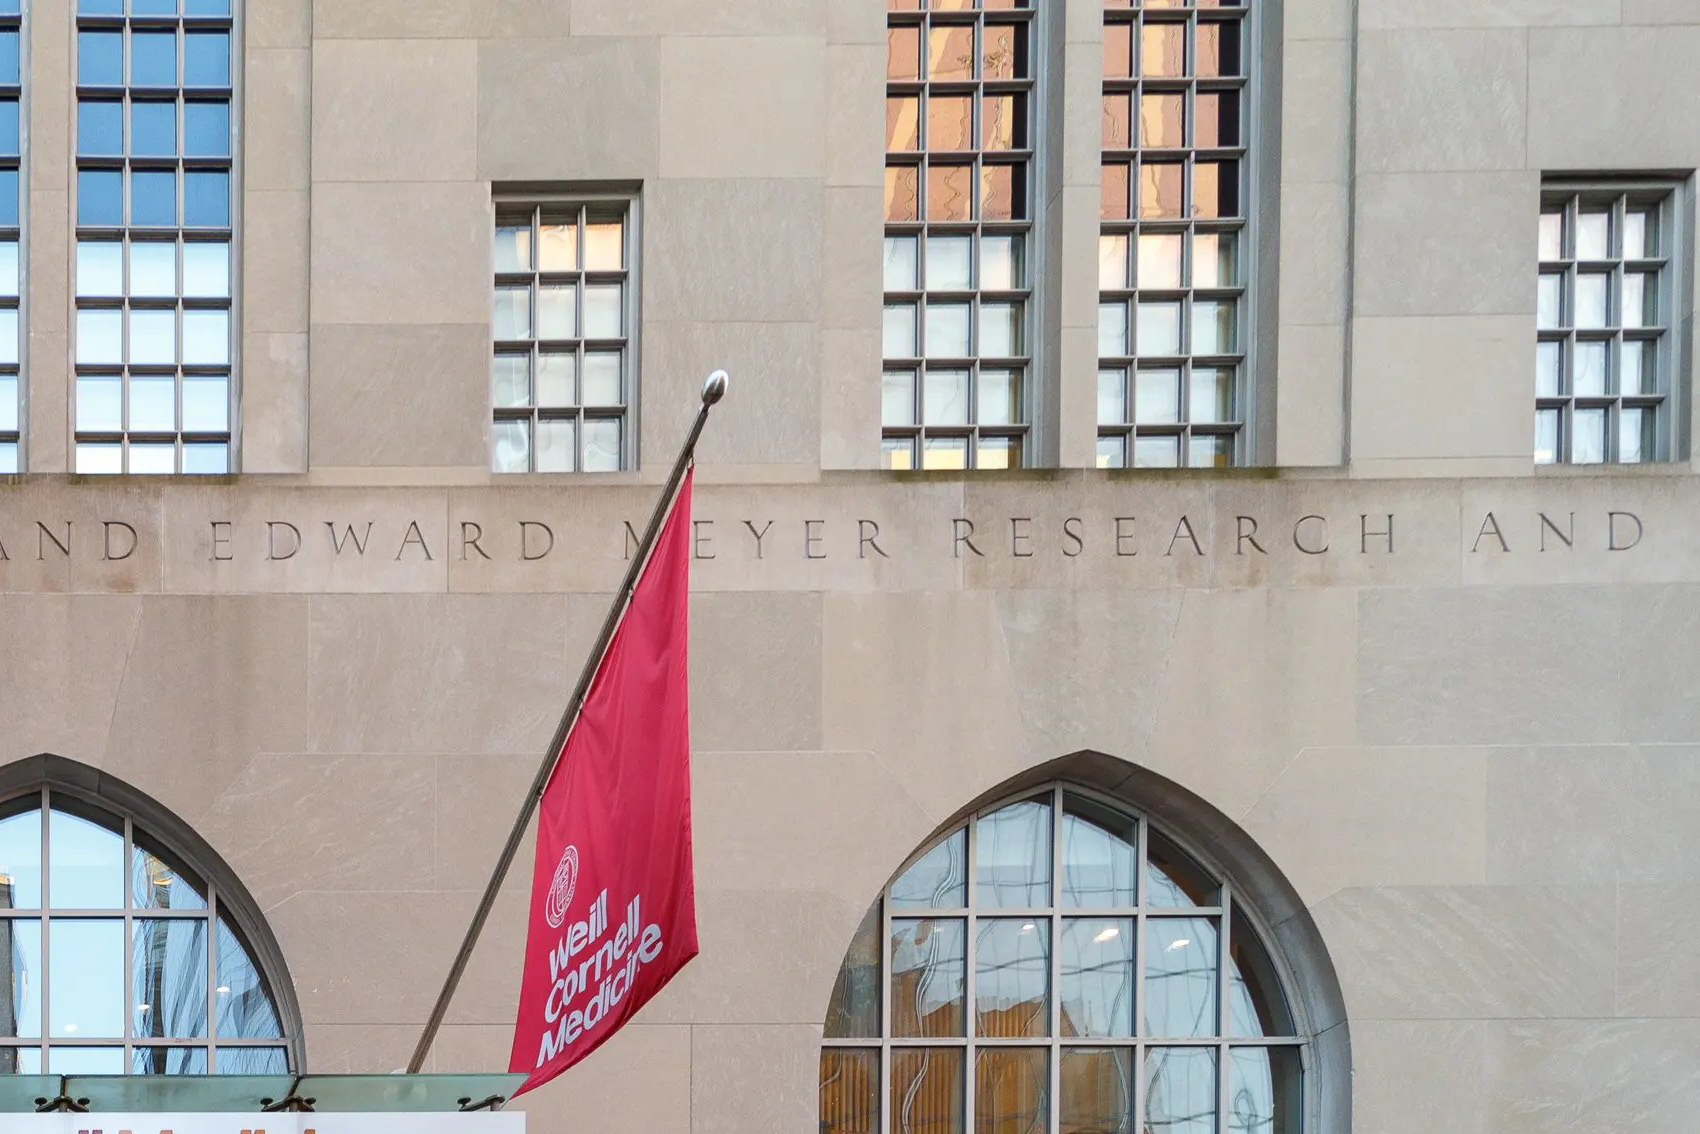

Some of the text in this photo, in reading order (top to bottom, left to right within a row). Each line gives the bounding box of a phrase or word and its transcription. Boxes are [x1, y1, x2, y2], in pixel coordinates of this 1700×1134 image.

[209, 519, 555, 562] EDWARD
[950, 514, 1396, 558] RESEARCH
[1471, 510, 1645, 554] AND
[545, 894, 640, 1024] Cornell
[549, 888, 607, 984] Weill
[536, 924, 663, 1068] Medicine
